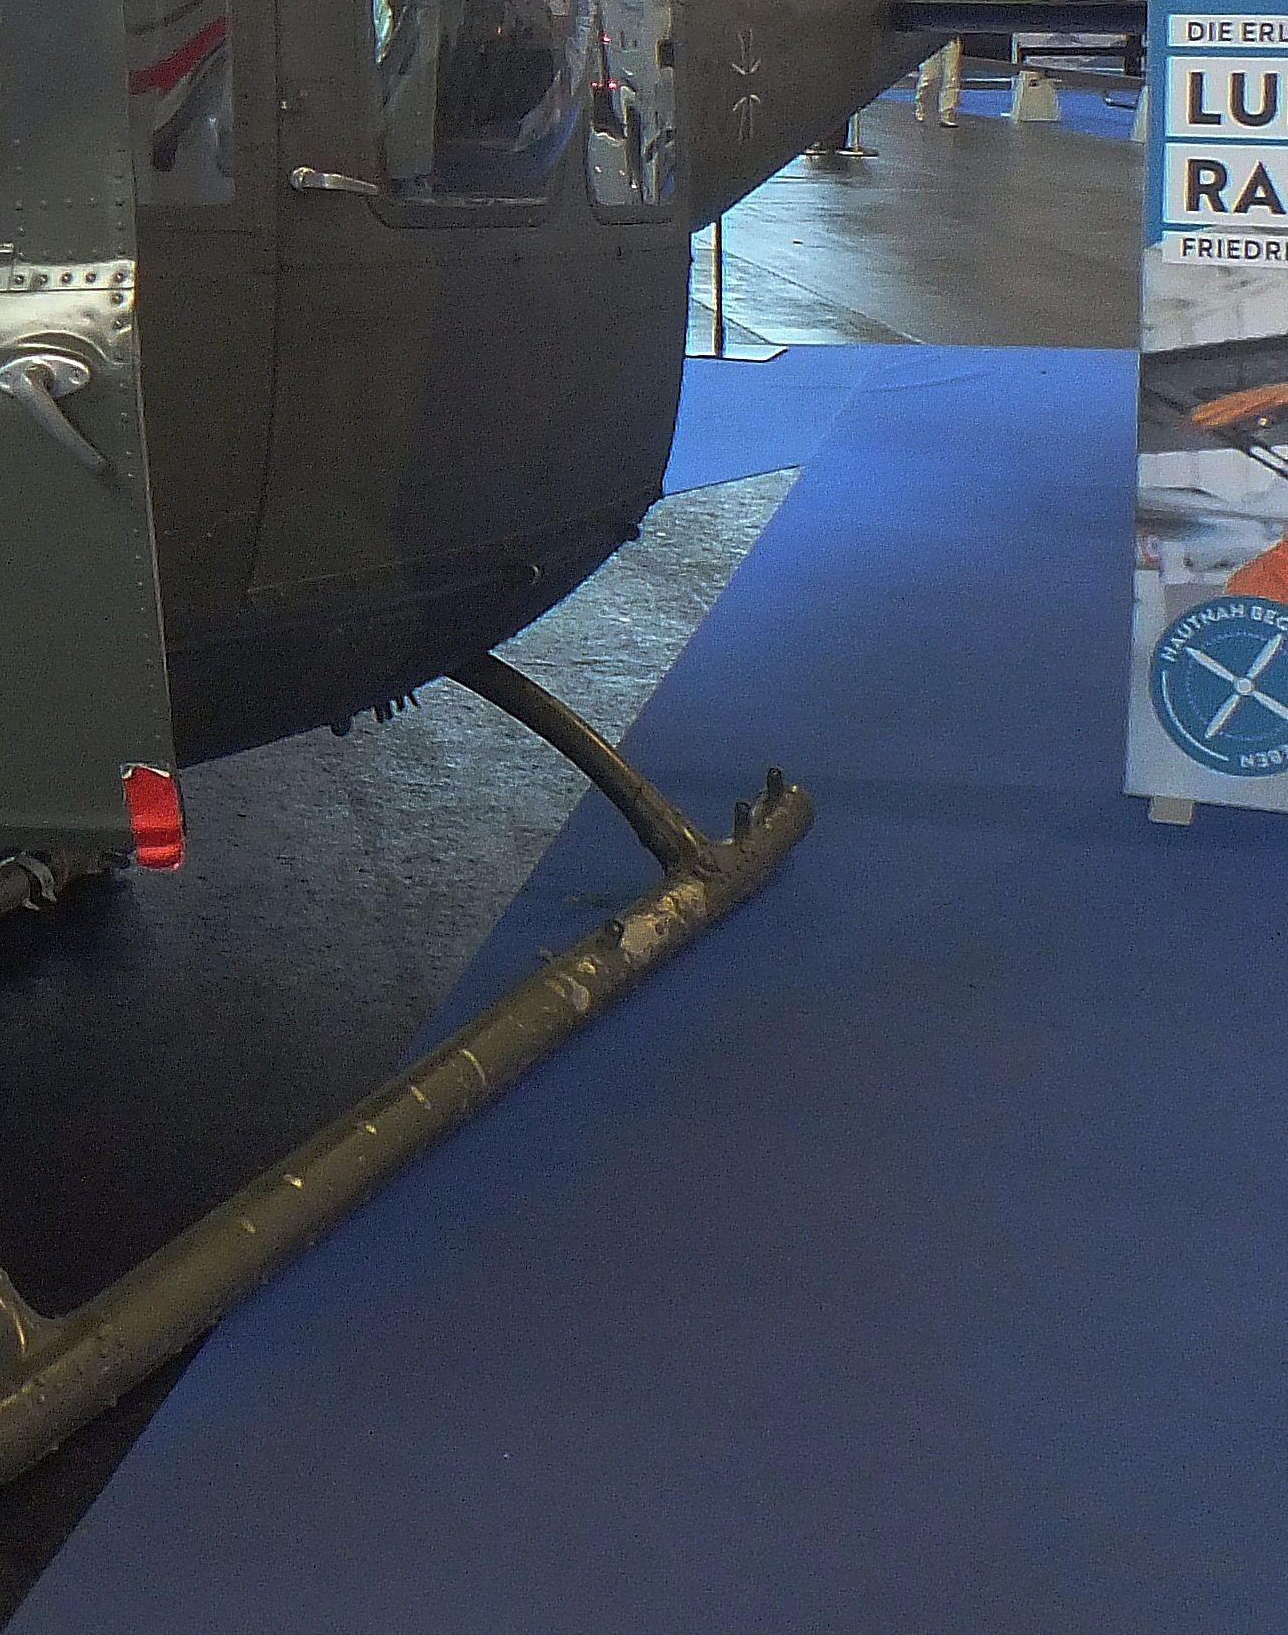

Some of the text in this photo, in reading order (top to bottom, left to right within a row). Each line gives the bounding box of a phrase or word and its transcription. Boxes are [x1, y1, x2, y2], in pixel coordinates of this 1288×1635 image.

[1188, 21, 1288, 42] DIE ERL
[1188, 71, 1278, 127] LU
[1185, 158, 1287, 215] RA
